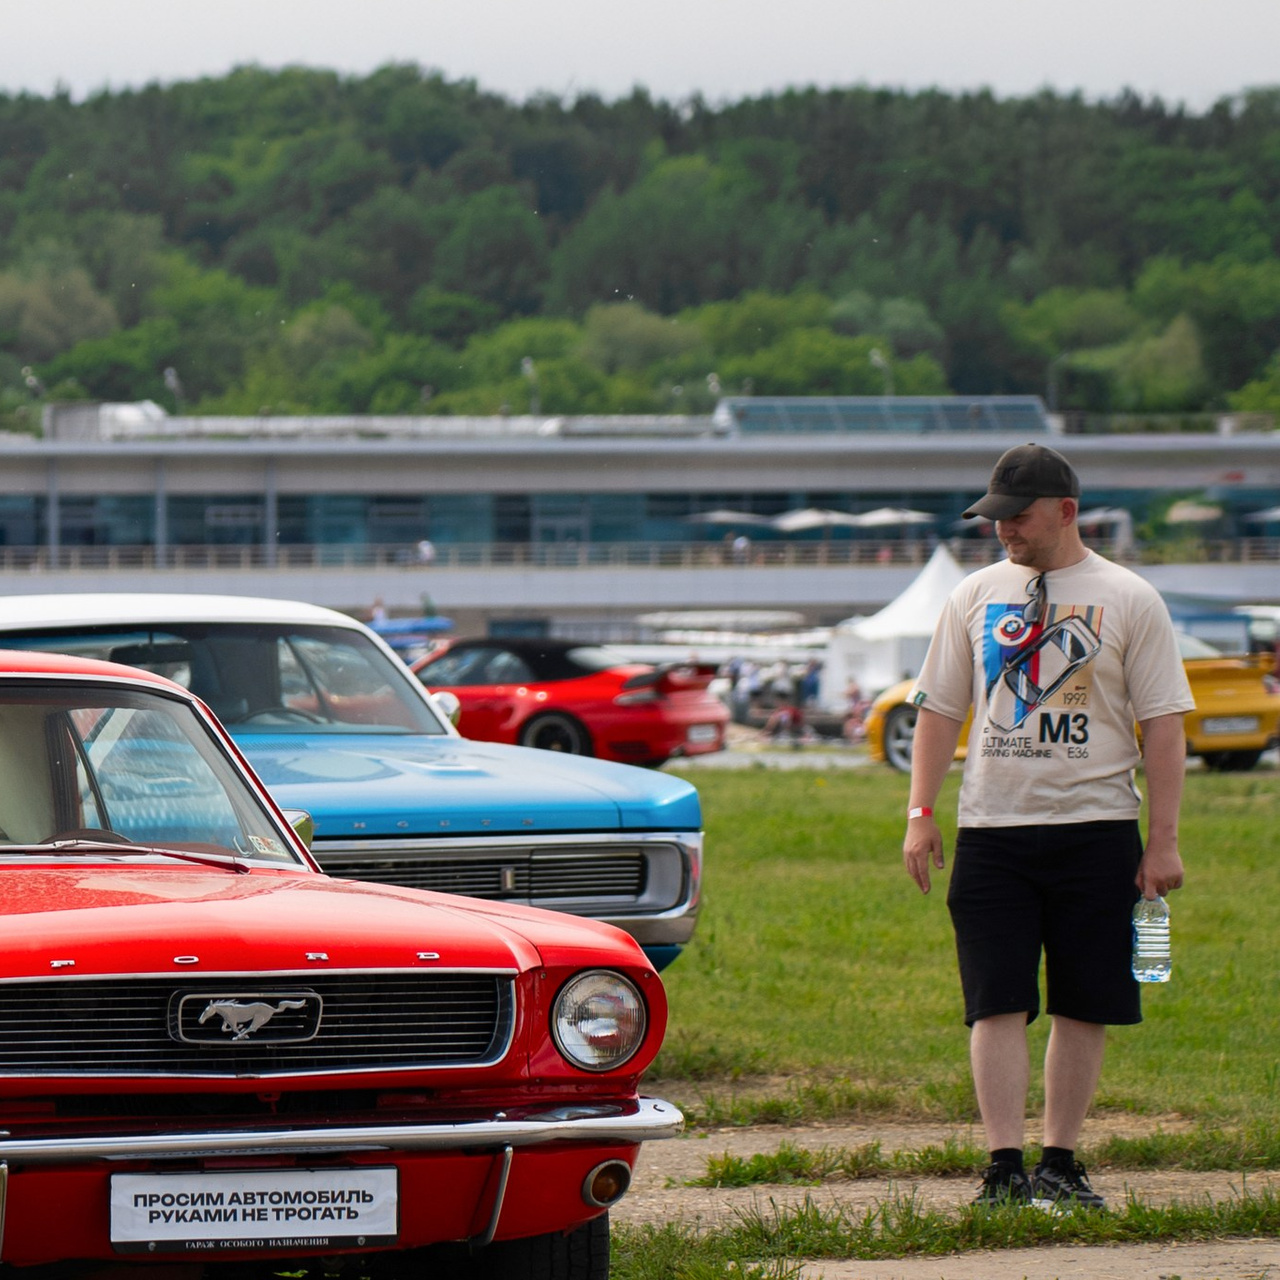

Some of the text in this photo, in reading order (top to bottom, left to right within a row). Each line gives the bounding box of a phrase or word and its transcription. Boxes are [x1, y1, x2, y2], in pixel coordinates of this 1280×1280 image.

[1063, 692, 1088, 706] 1992
[1039, 713, 1089, 744] M3
[1012, 749, 1052, 758] MACHINE
[1067, 746, 1089, 759] E36
[50, 952, 440, 968] FORD
[133, 1190, 374, 1208] ПРОСИМ АВТОМОБИЛЬ
[148, 1207, 359, 1223] РУКАМИ НЕ ТРОГАТЬ
[185, 1238, 329, 1249] ГАРАЖ ОСОБОГО НАЗНАЧЕНИЯ
